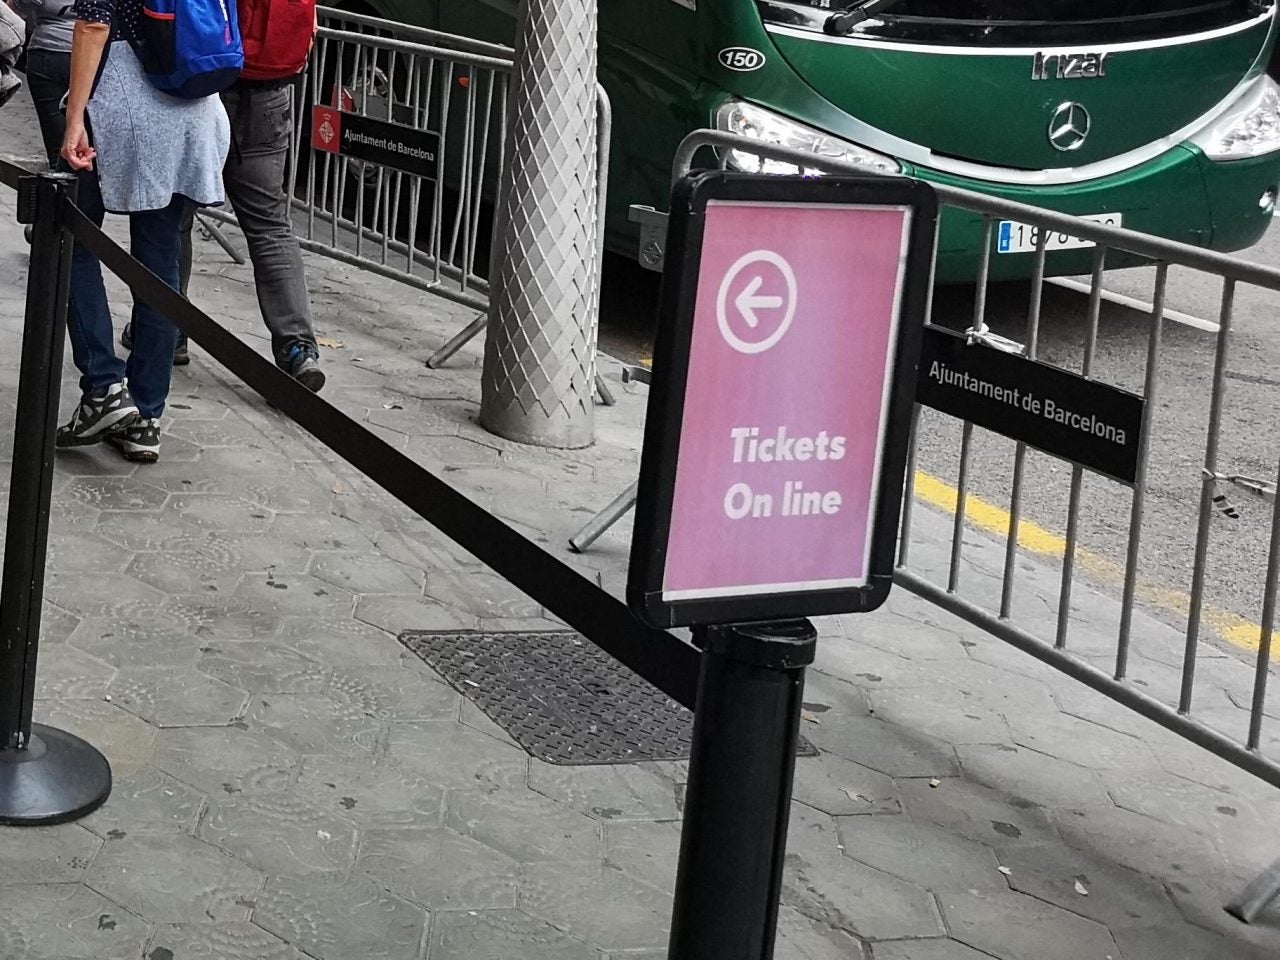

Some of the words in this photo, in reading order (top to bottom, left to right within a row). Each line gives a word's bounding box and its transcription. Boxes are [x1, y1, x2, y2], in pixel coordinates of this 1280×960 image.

[725, 51, 758, 67] 150
[344, 128, 387, 149] Ajuntament
[387, 141, 397, 152] de
[397, 142, 434, 161] Barcelona
[928, 360, 1020, 408] Ajuntament
[1021, 392, 1041, 415] de
[1043, 399, 1126, 446] Barcelona
[730, 426, 847, 463] Tickets
[723, 482, 773, 520] On
[781, 480, 842, 517] line
